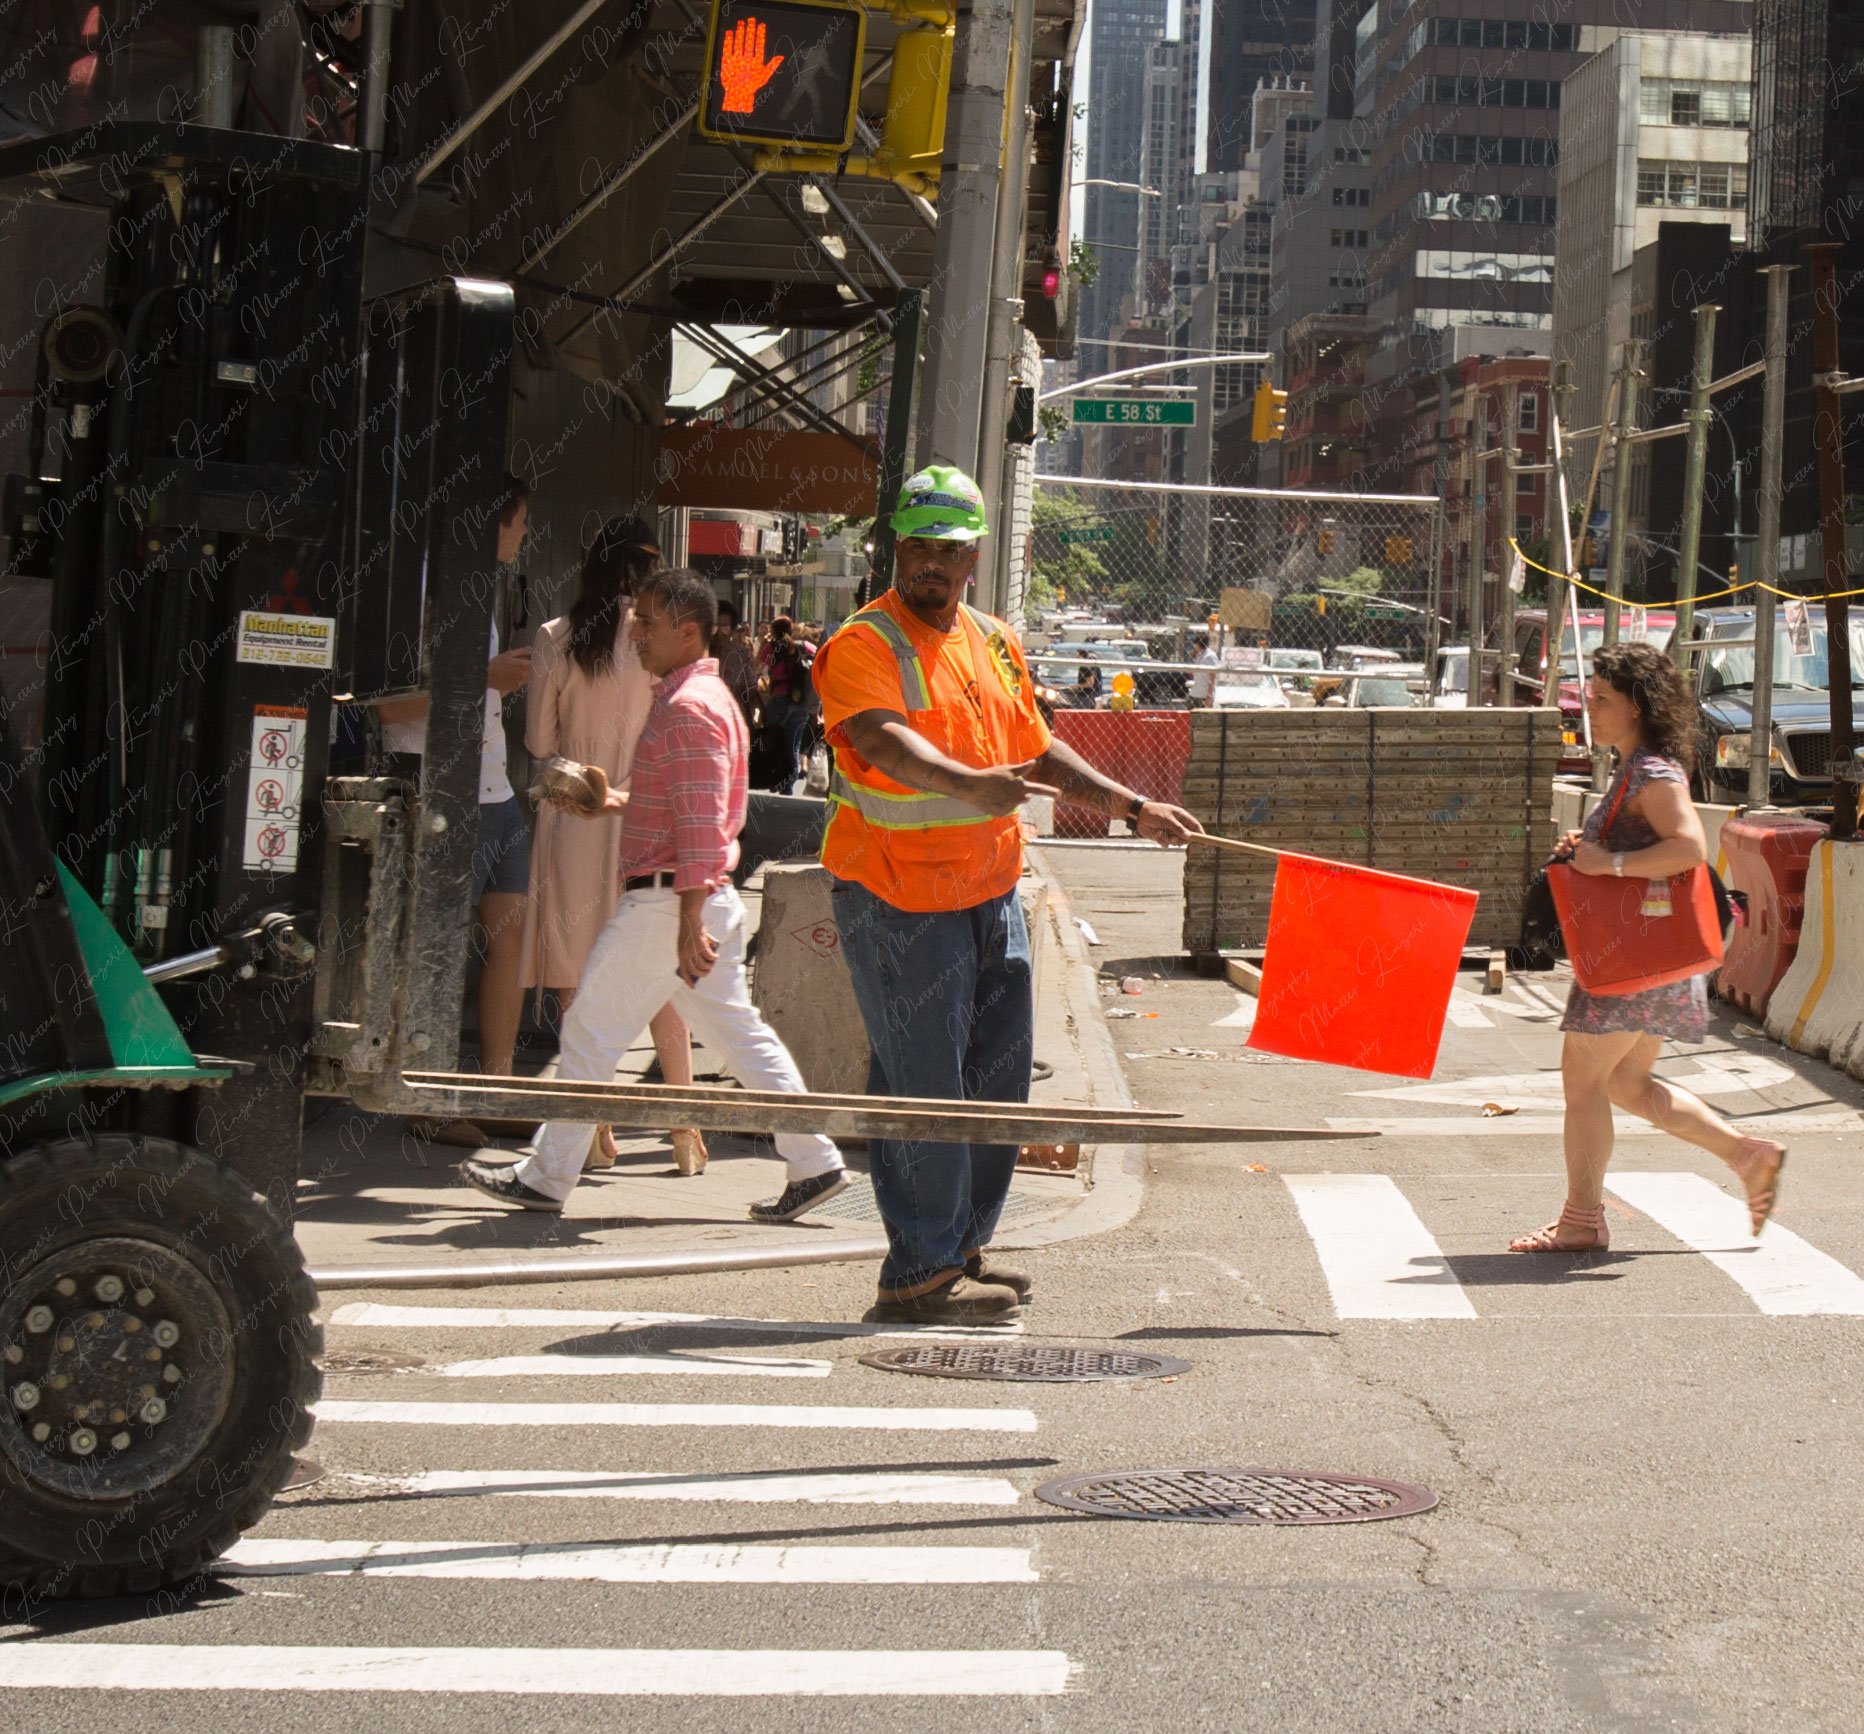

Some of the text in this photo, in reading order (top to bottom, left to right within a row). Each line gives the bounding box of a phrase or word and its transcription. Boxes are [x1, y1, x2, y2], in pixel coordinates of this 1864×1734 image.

[1106, 404, 1162, 421] E 58 St
[688, 459, 785, 481] SAMUEL
[809, 464, 873, 485] SONS
[244, 613, 329, 638] Manhattan
[244, 634, 327, 648] Equipment Rental
